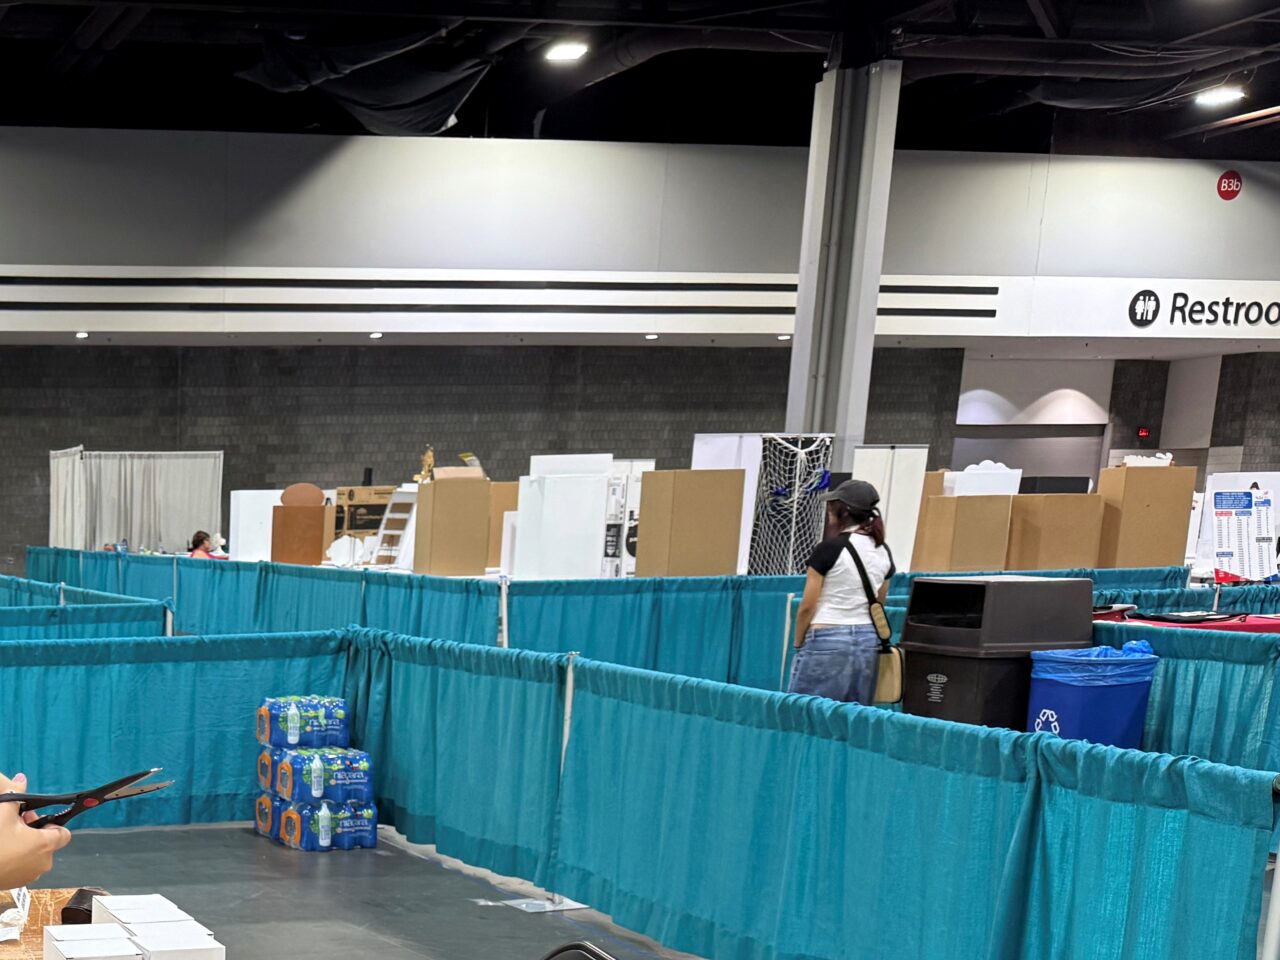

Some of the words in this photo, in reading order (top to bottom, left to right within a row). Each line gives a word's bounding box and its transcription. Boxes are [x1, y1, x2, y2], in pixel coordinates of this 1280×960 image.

[1221, 178, 1241, 191] B3b
[1169, 292, 1280, 325] Restroo
[333, 771, 364, 784] niagara
